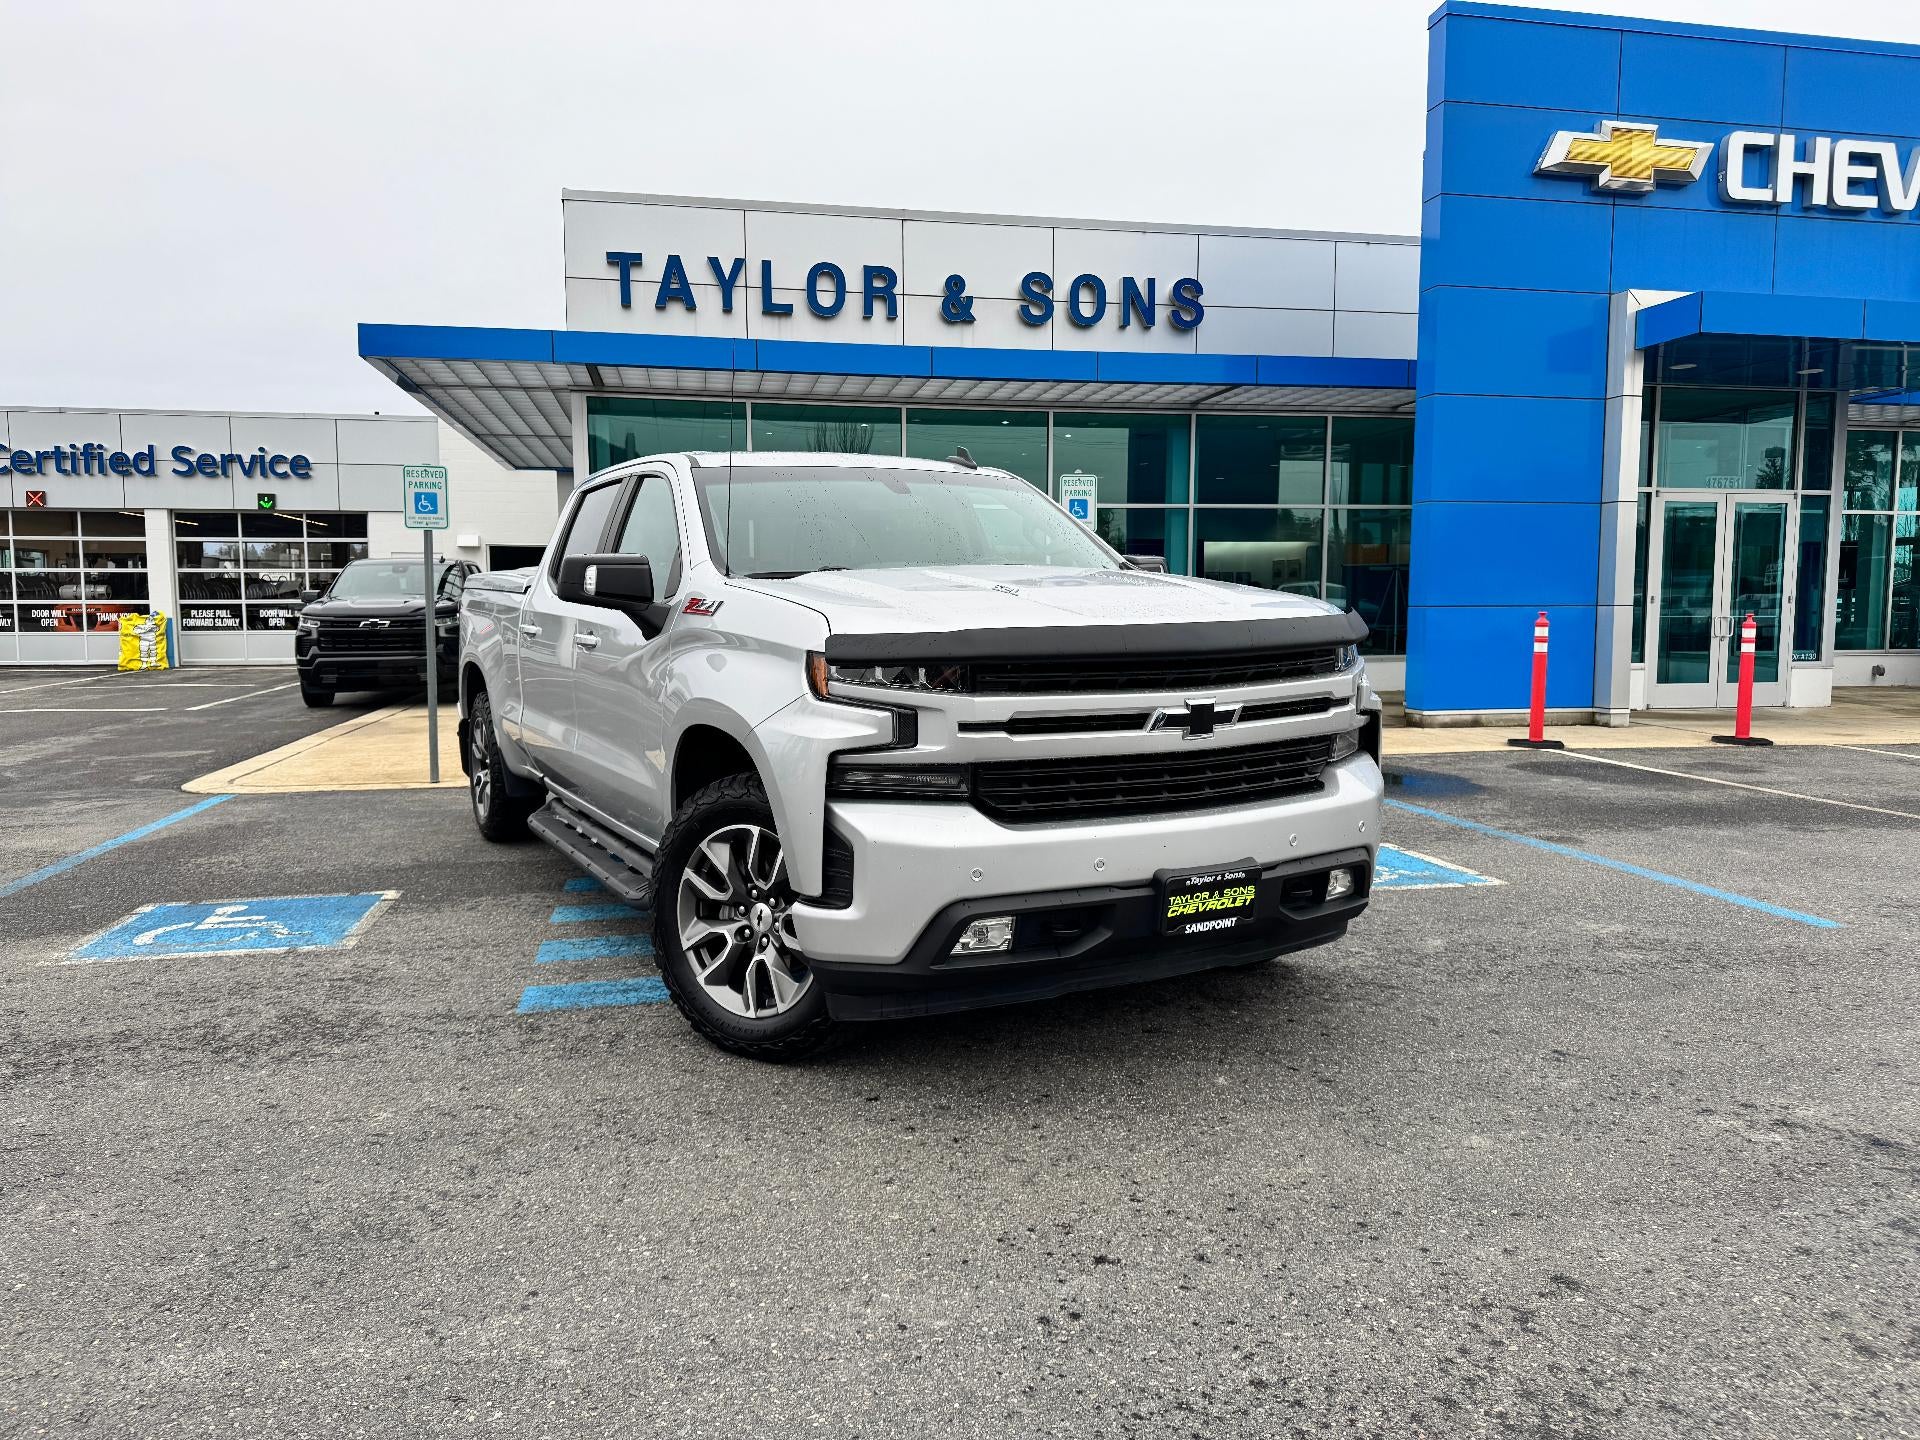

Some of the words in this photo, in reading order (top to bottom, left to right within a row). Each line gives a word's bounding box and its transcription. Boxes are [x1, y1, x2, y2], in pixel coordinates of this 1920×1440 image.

[1719, 130, 1920, 212] CHEV
[606, 250, 898, 320] TAYLOR
[940, 273, 977, 323] &
[1018, 271, 1205, 330] SONS
[171, 445, 311, 479] Service
[406, 469, 444, 479] RESERVED
[408, 481, 442, 490] PARKING
[1063, 479, 1094, 487] RESERVED
[1064, 489, 1092, 497] PARKING
[31, 609, 51, 618] DOOR
[51, 609, 68, 618] WILL
[96, 612, 118, 621] THANK
[190, 609, 215, 618] PLEASE
[215, 609, 231, 618] PULL
[259, 609, 278, 618] DOOR
[278, 609, 293, 618] WILL
[41, 618, 59, 627] OPEN
[182, 618, 214, 627] FORWARD
[214, 618, 240, 627] SLOWLY
[268, 617, 285, 627] OPEN
[1190, 875, 1215, 885] Taylor
[1223, 872, 1243, 881] Sons
[1168, 891, 1210, 906] TAYLOR
[1212, 891, 1220, 900] &
[1223, 885, 1255, 897] SONS
[1167, 896, 1255, 917] CHEVROLET
[1185, 917, 1237, 934] SANDPOINT
